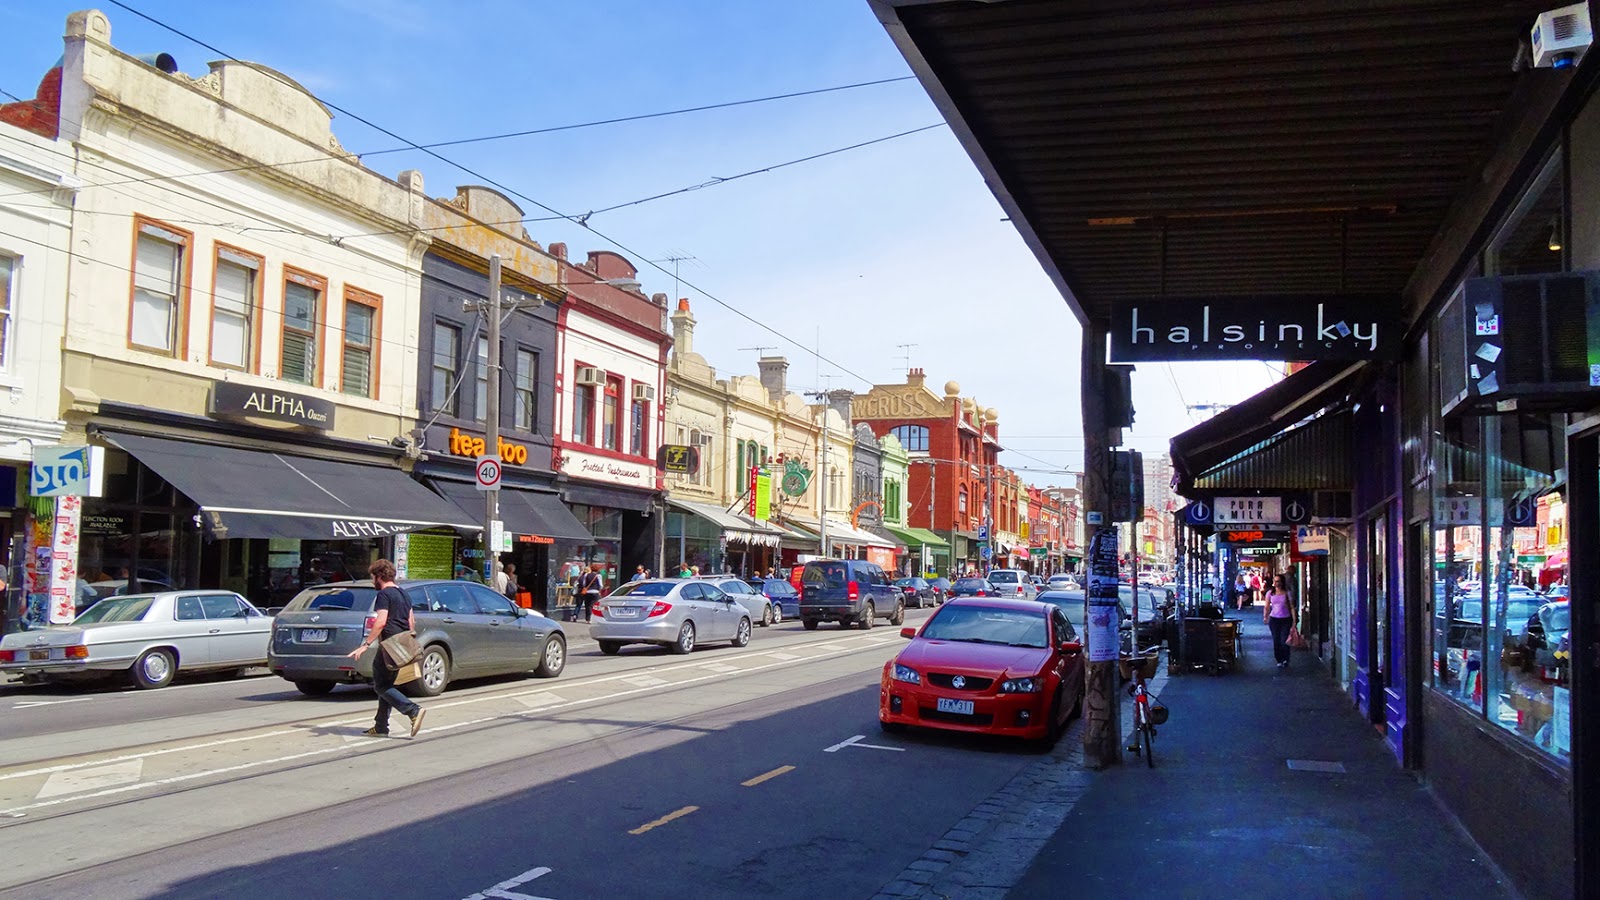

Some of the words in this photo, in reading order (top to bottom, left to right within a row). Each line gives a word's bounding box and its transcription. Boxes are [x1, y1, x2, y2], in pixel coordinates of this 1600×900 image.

[1131, 303, 1377, 351] halsinky
[243, 392, 305, 418] ALPHA
[449, 428, 486, 458] tea
[497, 436, 528, 465] too
[481, 467, 496, 479] 40
[1230, 510, 1264, 520] MILK
[332, 520, 390, 537] ALPHA
[979, 527, 986, 536] P
